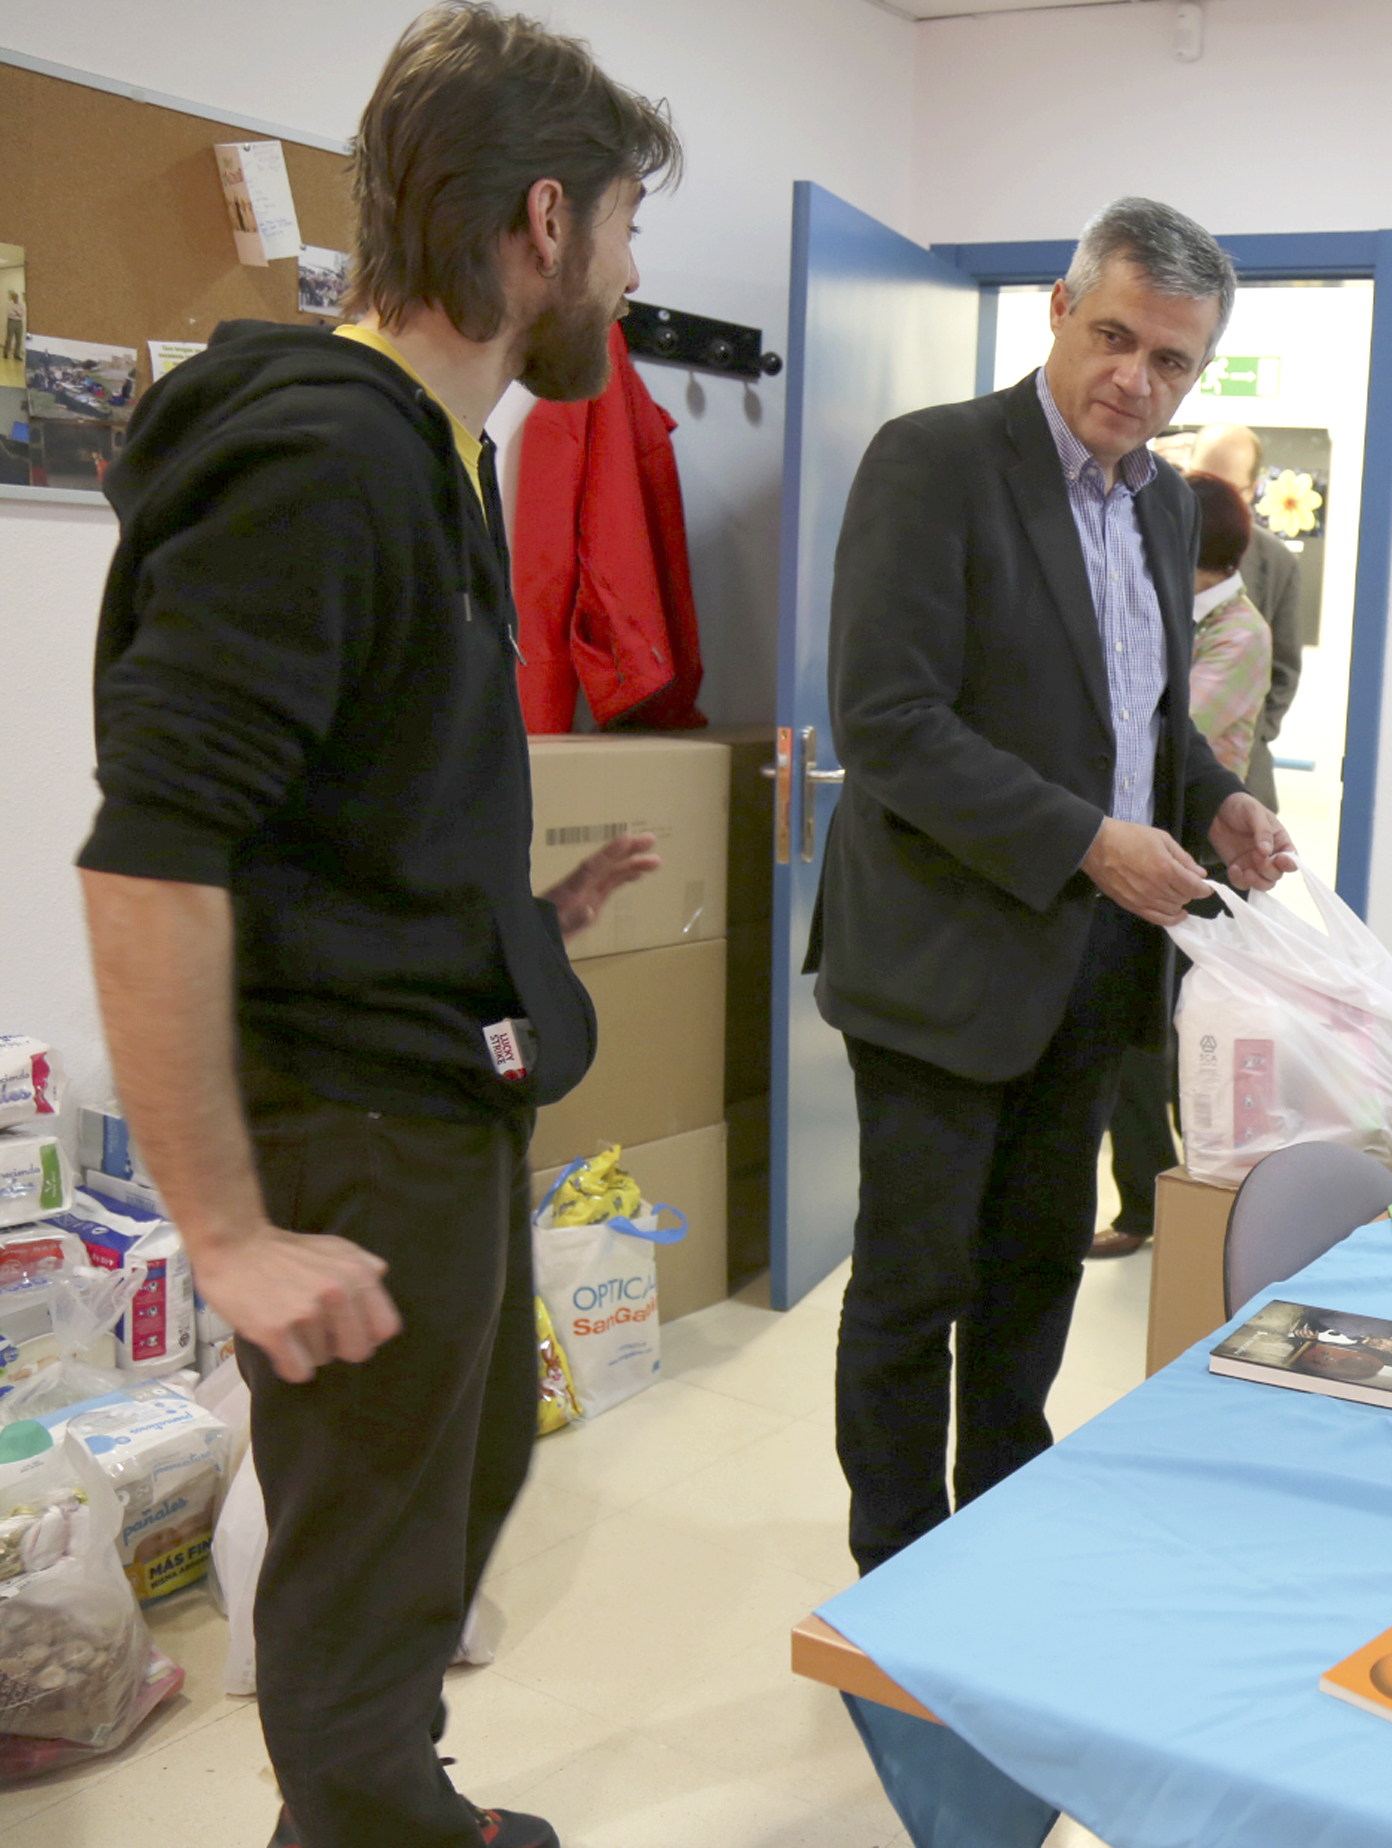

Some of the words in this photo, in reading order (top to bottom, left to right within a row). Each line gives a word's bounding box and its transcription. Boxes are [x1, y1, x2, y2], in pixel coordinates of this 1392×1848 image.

[490, 1034, 506, 1065] STRIKE
[500, 1032, 515, 1061] LUCKY
[1199, 1054, 1218, 1062] SCA
[123, 1498, 188, 1546] pañales
[150, 1550, 186, 1579] MÁS
[188, 1537, 212, 1560] FIN
